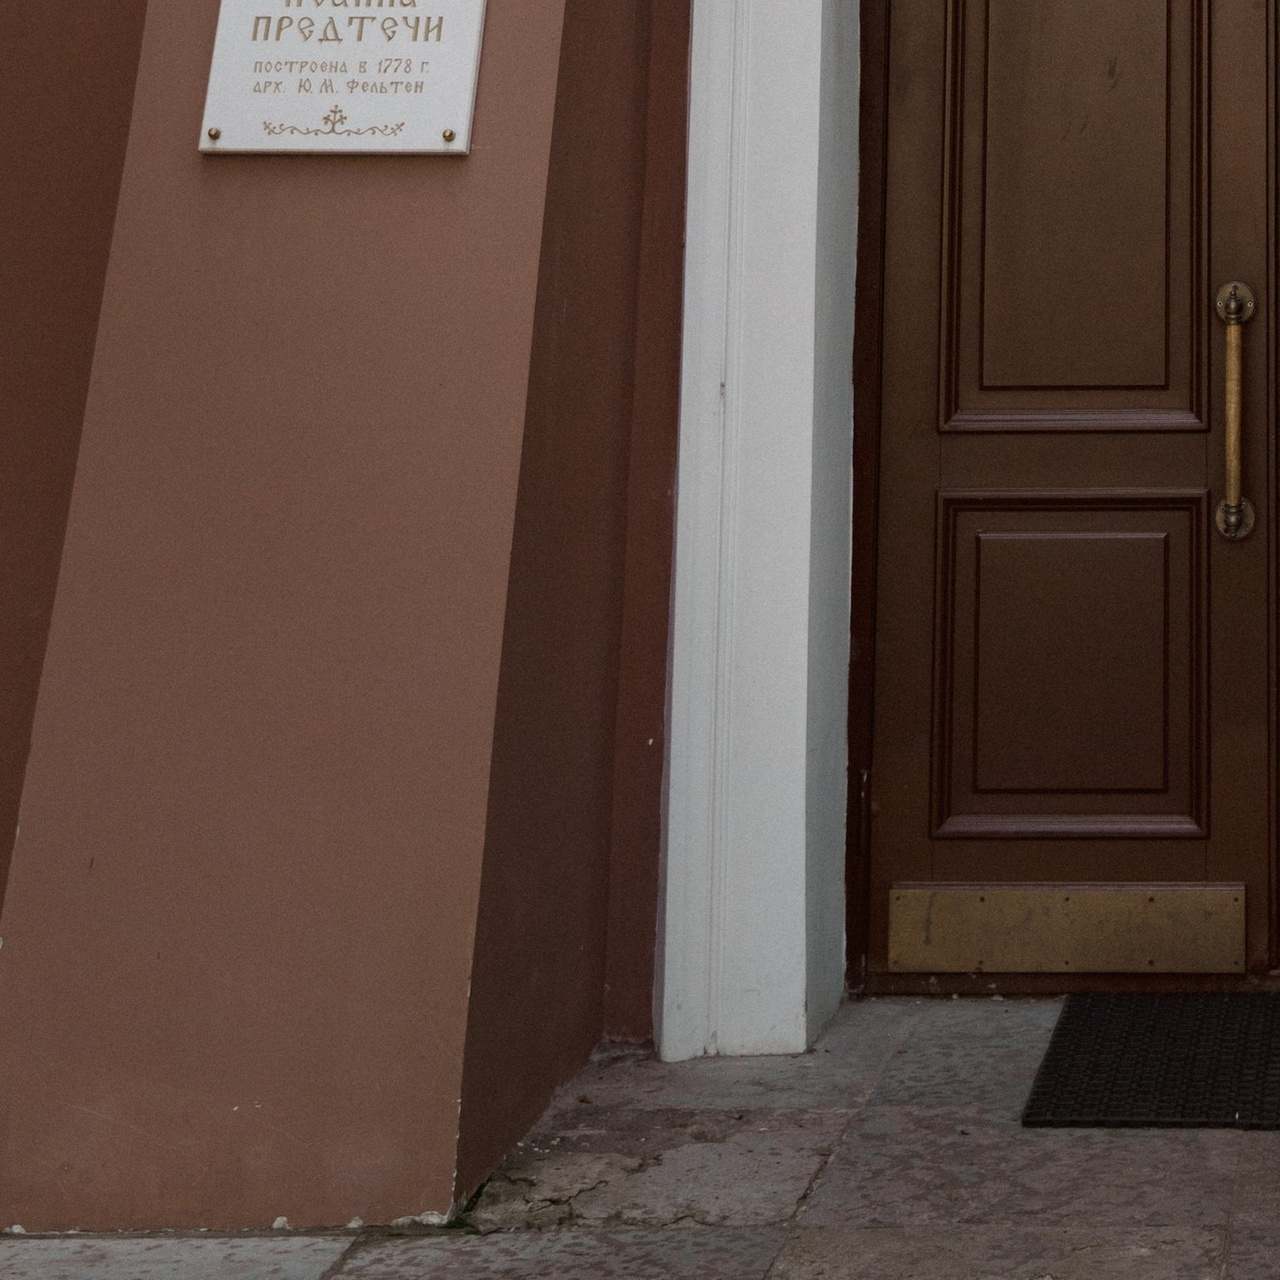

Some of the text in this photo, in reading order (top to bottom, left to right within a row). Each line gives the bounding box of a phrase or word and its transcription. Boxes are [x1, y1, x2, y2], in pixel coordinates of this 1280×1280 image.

[252, 15, 444, 43] ПРЕДТЕЧИ
[253, 61, 348, 74] ПОСТРОЕНА
[377, 58, 413, 74] 1778
[346, 78, 424, 94] ФЕЛЬТЕН
